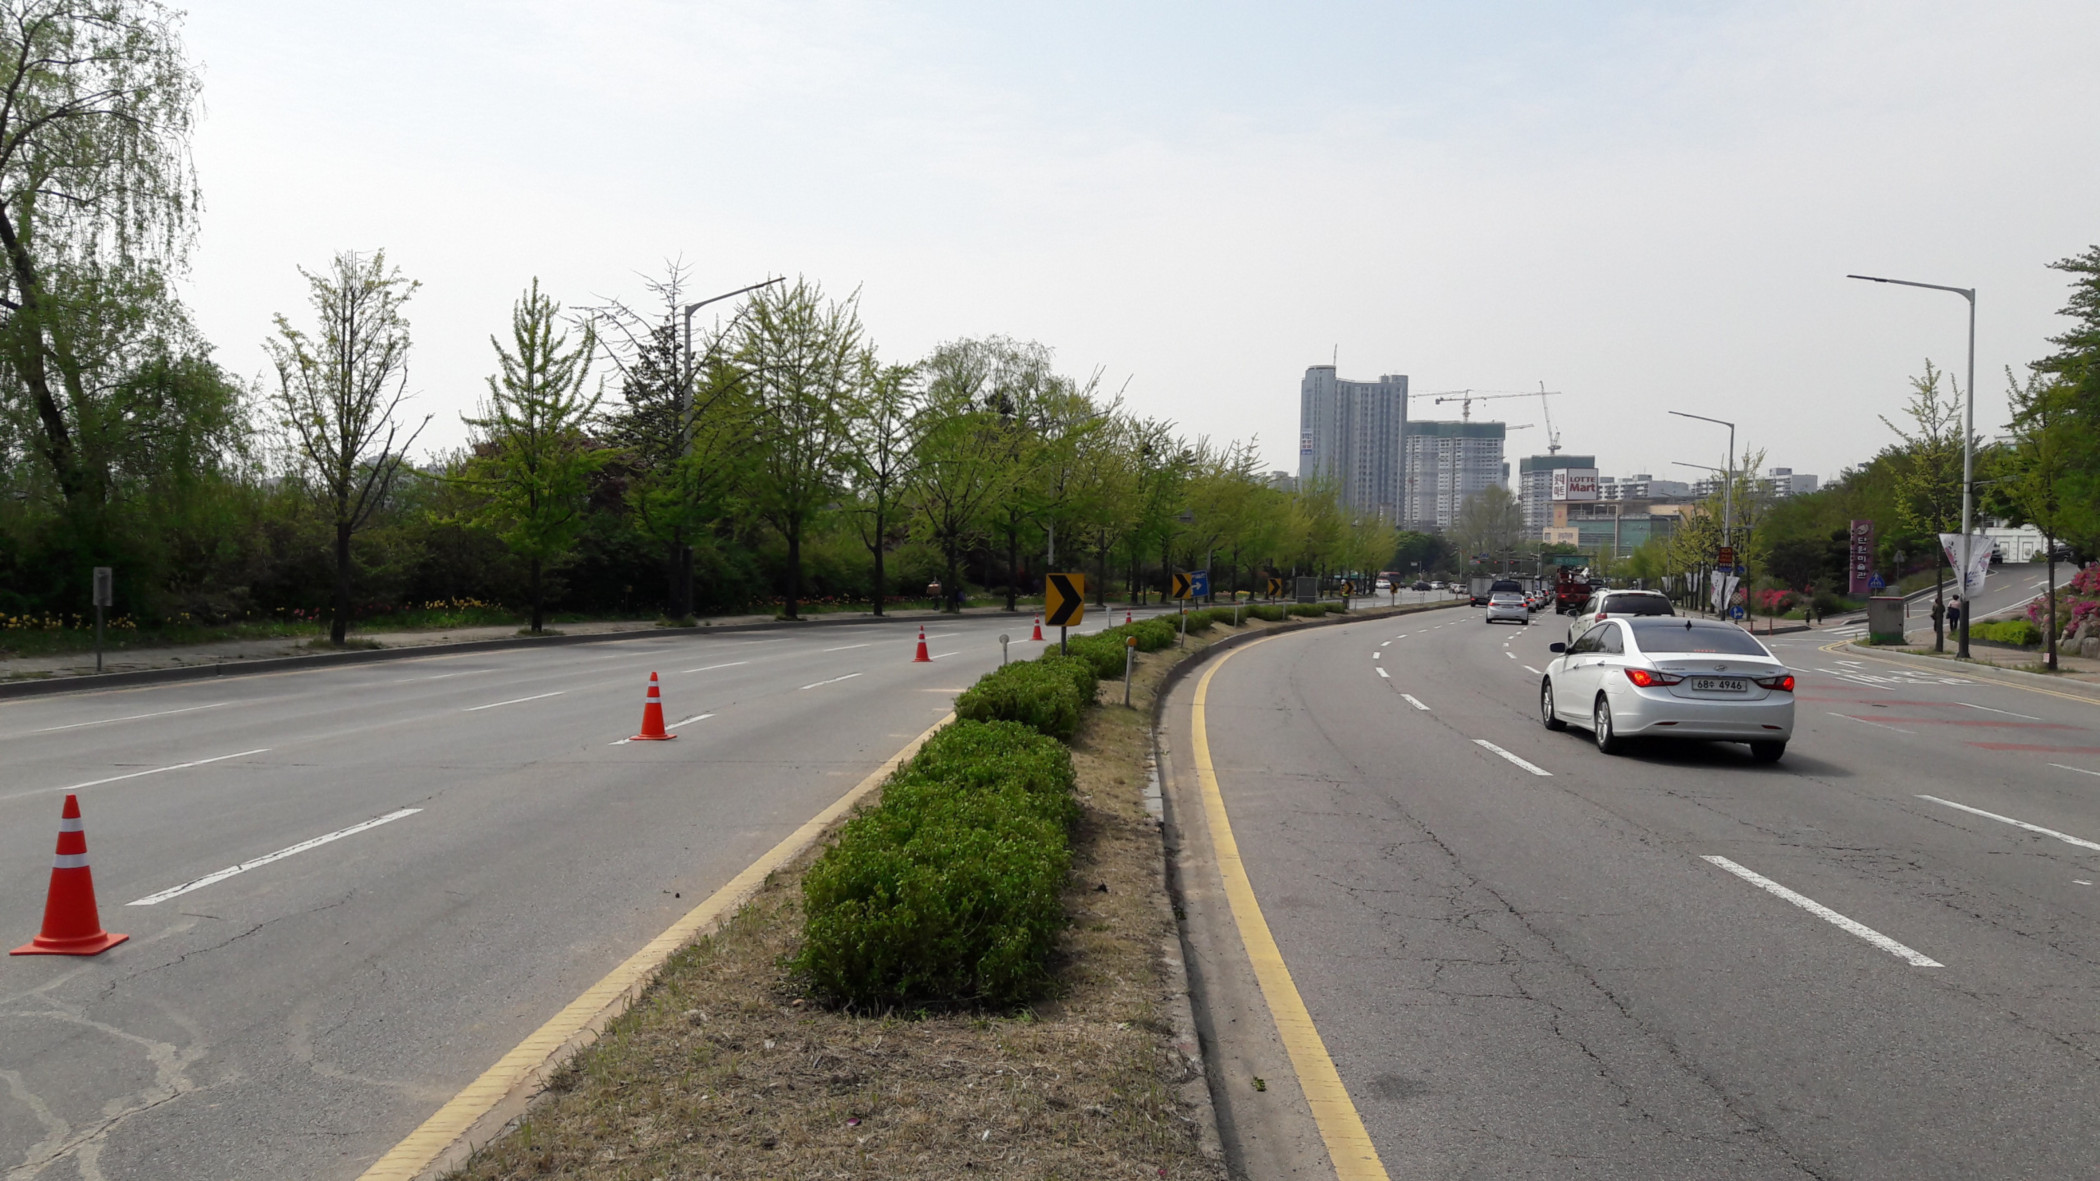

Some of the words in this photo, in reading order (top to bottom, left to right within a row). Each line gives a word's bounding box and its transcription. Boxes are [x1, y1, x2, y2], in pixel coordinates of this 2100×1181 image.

[1554, 474, 1565, 485] 롯데
[1554, 486, 1565, 497] 마트
[1570, 483, 1596, 493] Mart
[1719, 680, 1742, 690] 4946
